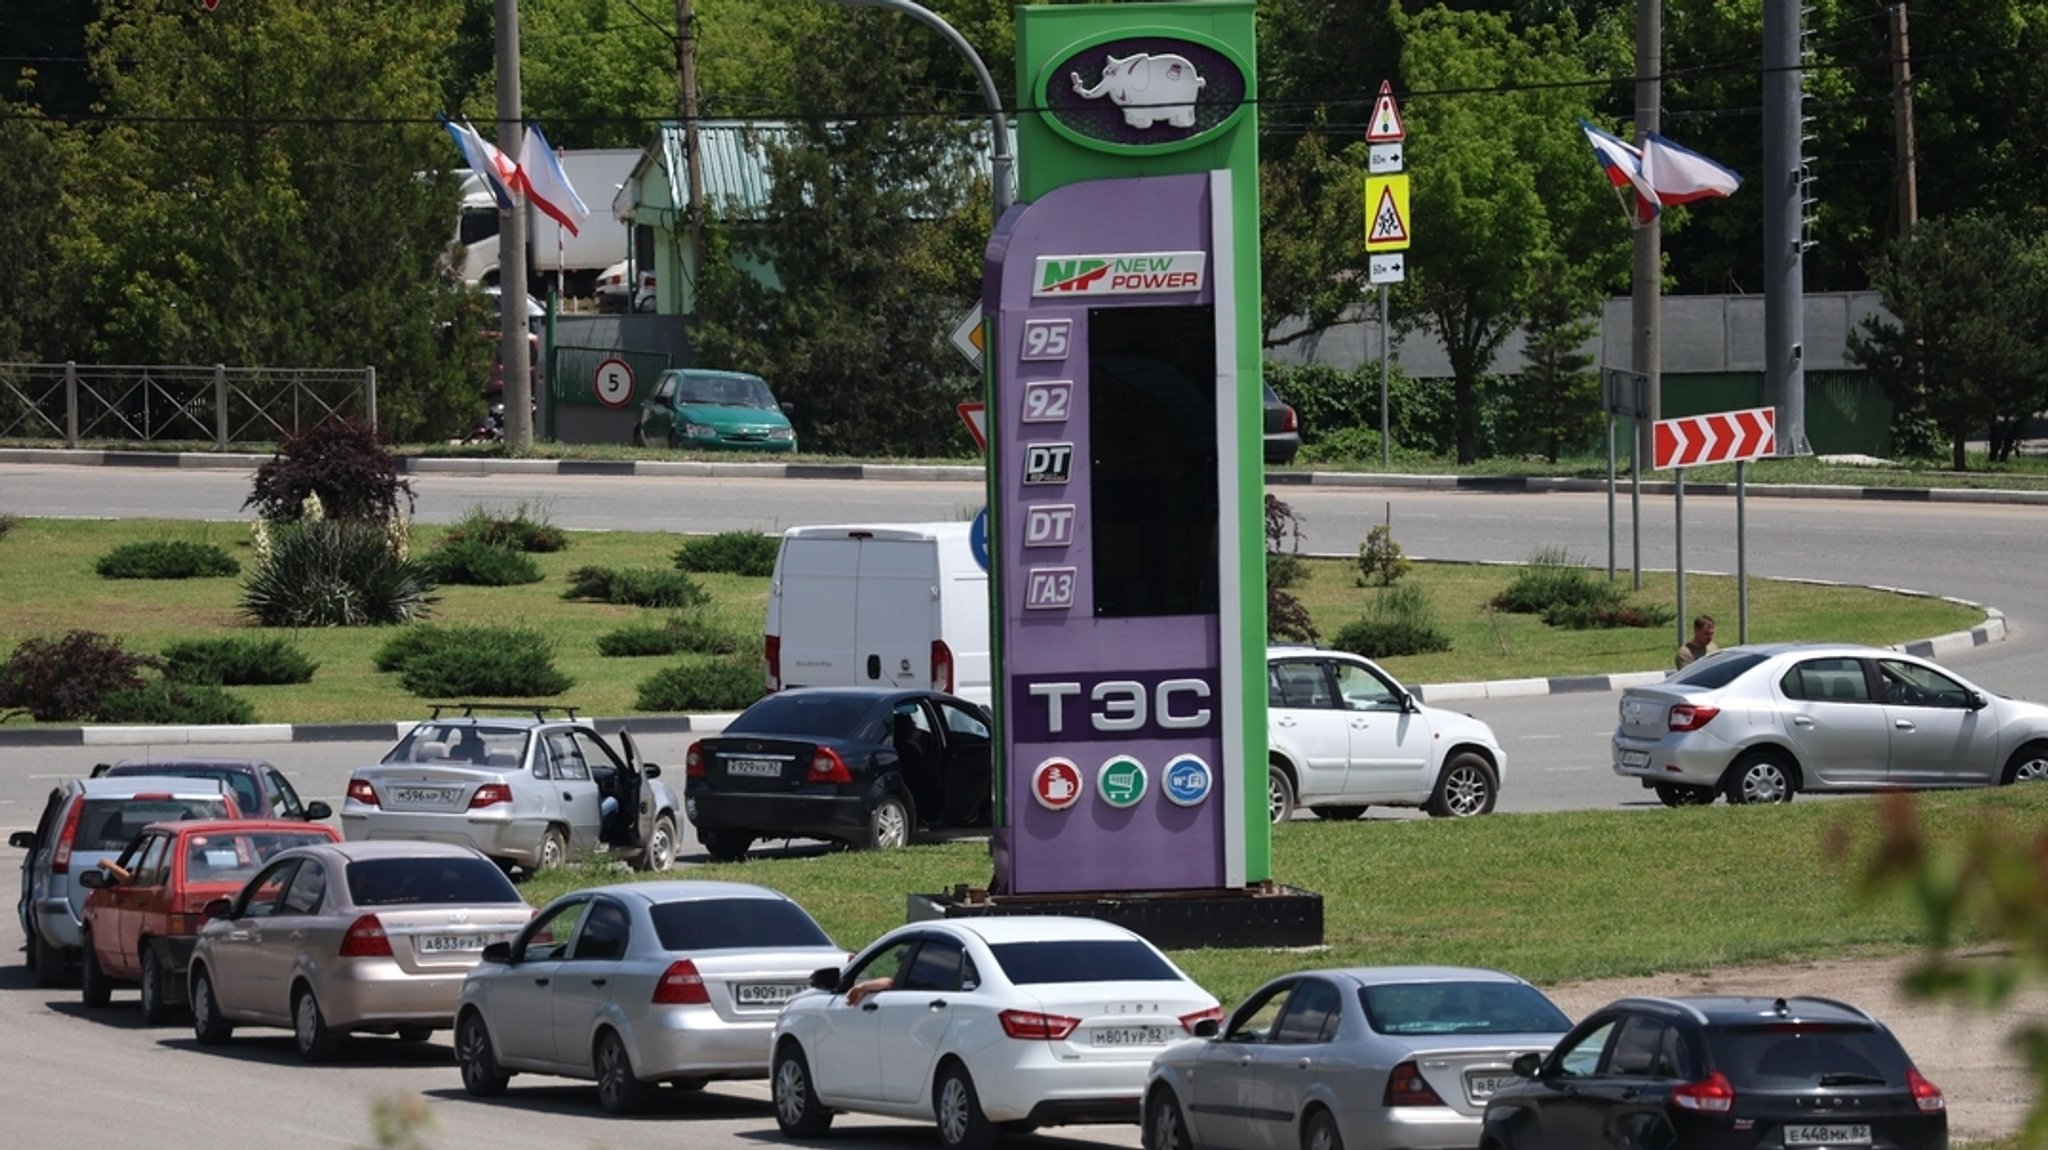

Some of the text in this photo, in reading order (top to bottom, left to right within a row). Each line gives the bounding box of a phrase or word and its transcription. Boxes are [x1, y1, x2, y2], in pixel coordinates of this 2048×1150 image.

[1114, 257, 1173, 273] NEW
[1111, 272, 1198, 290] POWER
[1027, 326, 1068, 355] 95
[608, 373, 619, 392] 5
[1028, 388, 1068, 417] 92
[1028, 447, 1070, 474] DT
[1029, 511, 1072, 541] DT
[1030, 574, 1072, 604] ГАЗ
[1029, 678, 1211, 733] ТЭС
